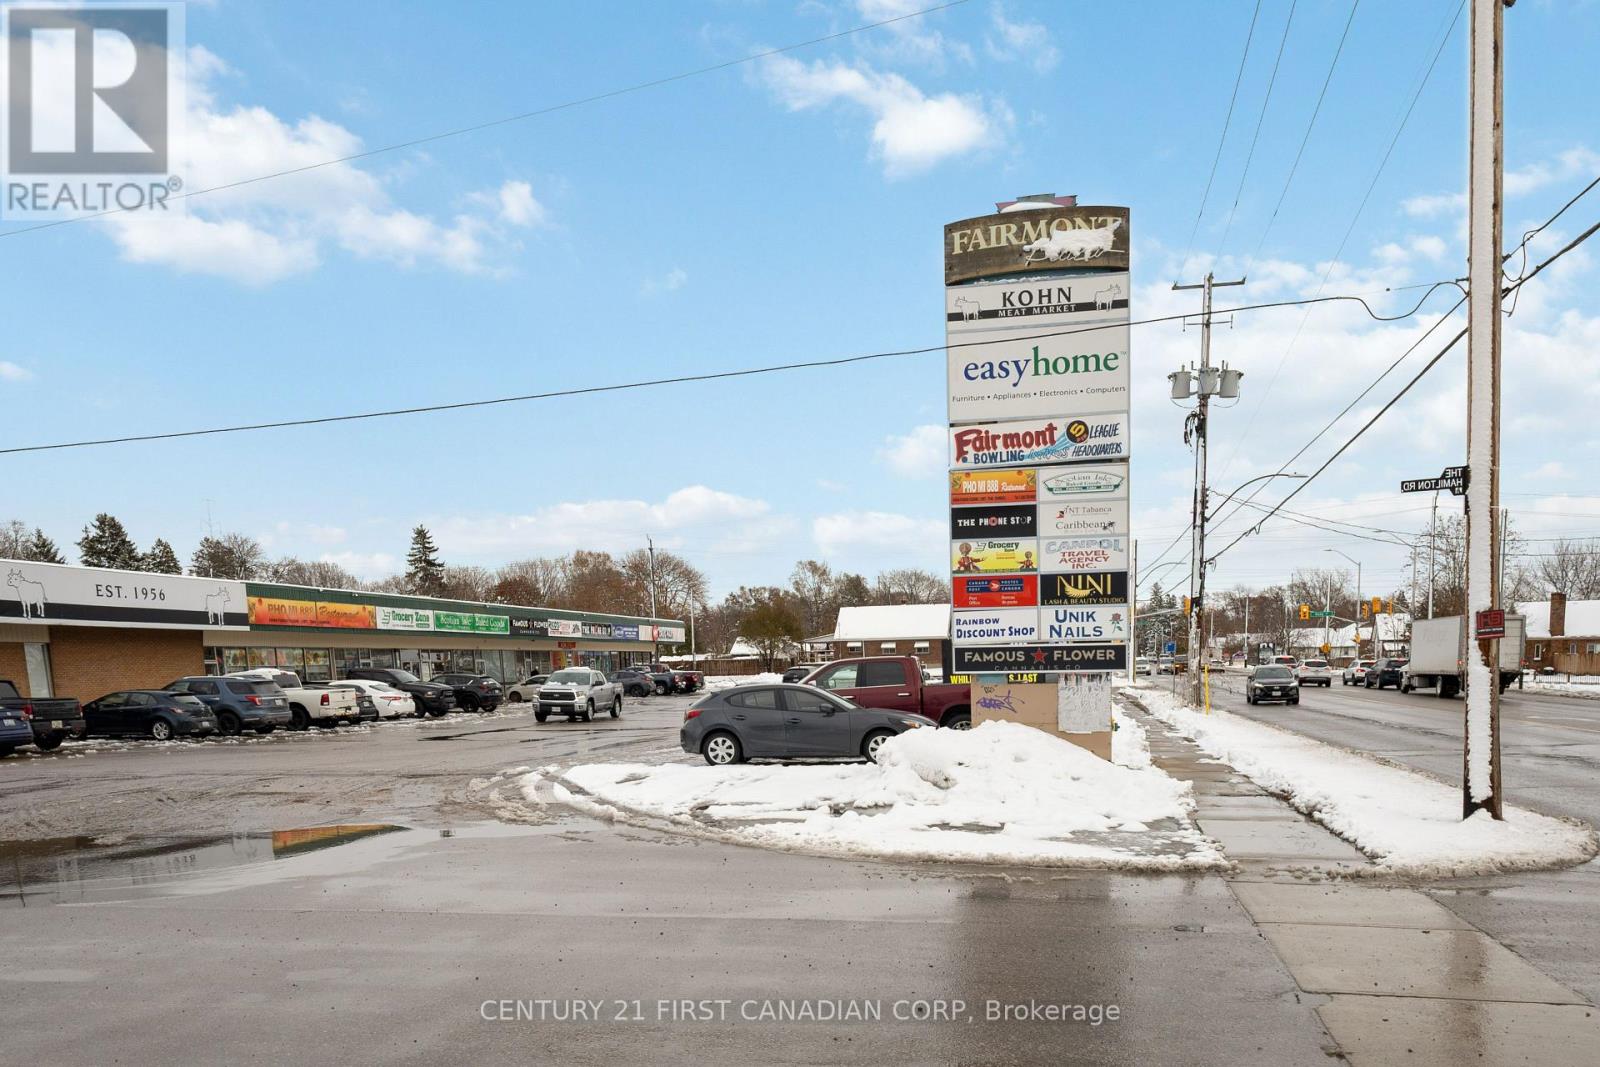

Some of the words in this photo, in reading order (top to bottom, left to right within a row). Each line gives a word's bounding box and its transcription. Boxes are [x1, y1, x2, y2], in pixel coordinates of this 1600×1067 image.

[1002, 287, 1072, 308] KOHN
[998, 308, 1026, 317] MEAT
[1033, 304, 1077, 315] MARKET
[952, 394, 985, 403] Furniture
[993, 391, 1031, 401] Appliances
[1039, 389, 1078, 397] Electronics
[1086, 386, 1126, 395] Computers
[1089, 423, 1120, 439] LEAGUE
[954, 422, 1058, 464] Fairmont
[1072, 442, 1122, 457] HEADQUARTERS
[973, 449, 1025, 464] BOWLING
[963, 481, 977, 493] PHO
[957, 519, 976, 527] THE
[979, 517, 1008, 526] PHONE
[1010, 516, 1032, 525] STOP
[1056, 521, 1107, 530] Caribbean
[988, 541, 1020, 549] Grocery
[1059, 556, 1110, 564] AGENCY
[96, 584, 127, 599] EST.
[134, 586, 166, 601] 1956
[1057, 574, 1112, 597] NINI
[392, 610, 414, 624] Grocery
[956, 618, 1000, 626] RAINBOW
[1055, 609, 1097, 623] UNIK
[956, 628, 1006, 639] DISCOUNT
[1008, 626, 1035, 636] SHOP
[1049, 624, 1104, 638] NAILS
[965, 651, 1026, 663] FAMOUS
[1053, 649, 1116, 661] FLOWER
